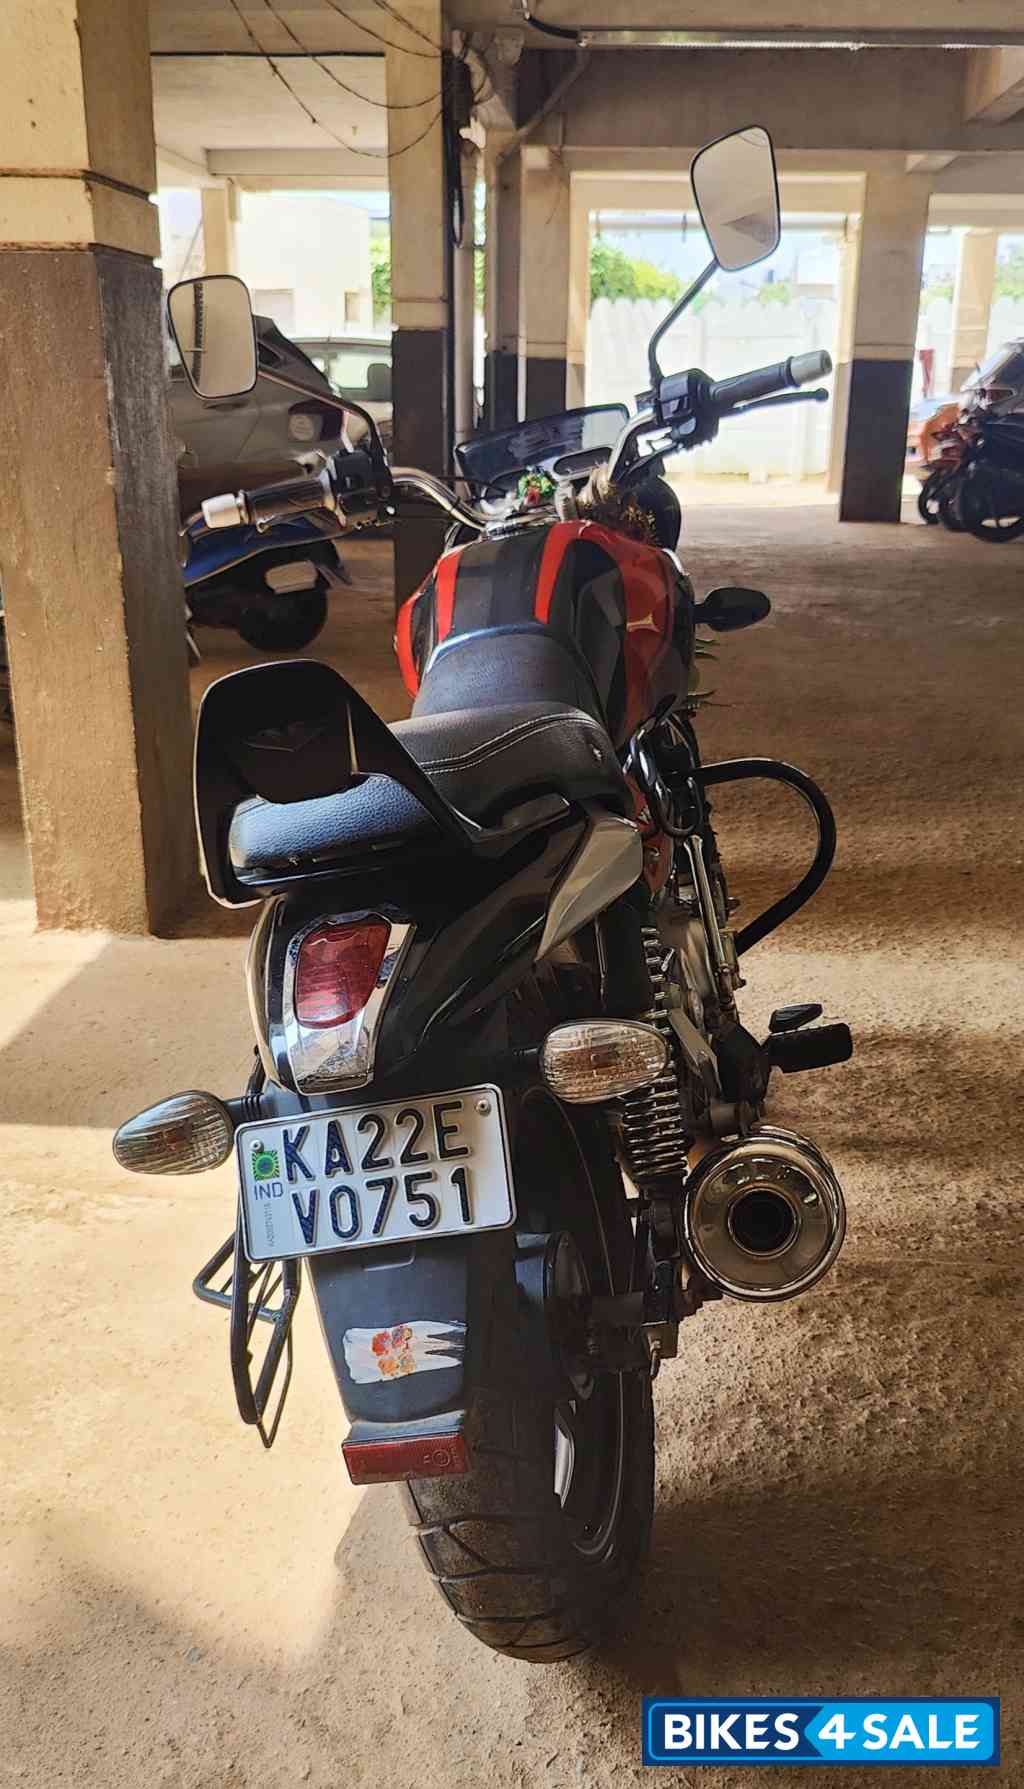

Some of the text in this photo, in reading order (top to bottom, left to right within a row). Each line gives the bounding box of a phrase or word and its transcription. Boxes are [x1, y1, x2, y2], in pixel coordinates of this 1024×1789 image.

[281, 1100, 471, 1183] KA22E
[254, 1182, 283, 1200] IND
[291, 1167, 472, 1245] V0751
